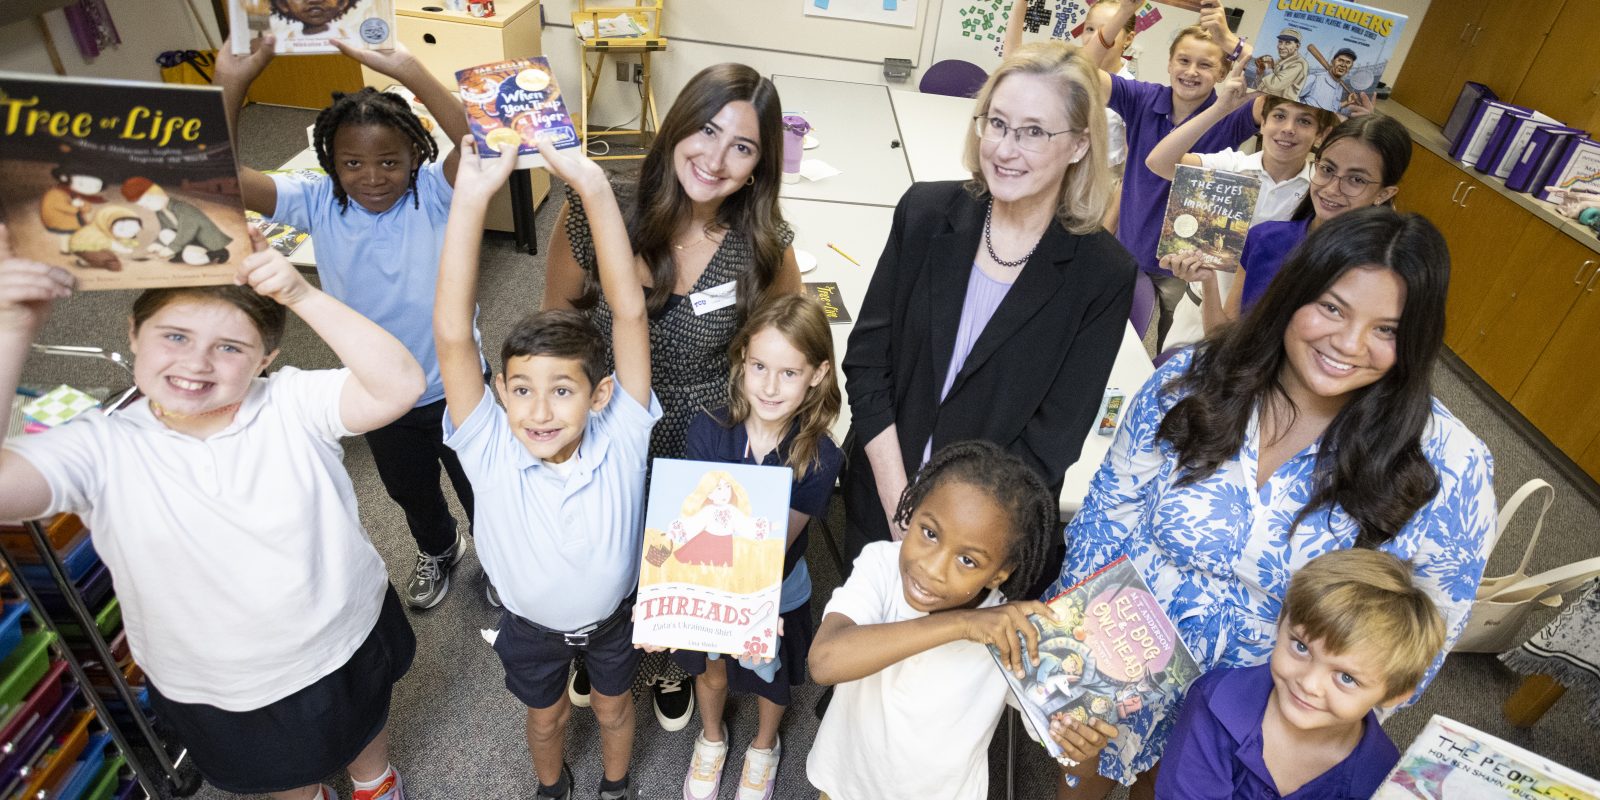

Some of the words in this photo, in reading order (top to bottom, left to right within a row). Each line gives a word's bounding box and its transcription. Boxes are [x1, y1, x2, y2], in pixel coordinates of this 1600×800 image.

[1277, 0, 1394, 37] CONTENDERS
[501, 89, 544, 103] When
[0, 88, 92, 137] Tree
[119, 105, 202, 147] Life
[501, 101, 531, 118] You
[530, 99, 561, 114] Trap
[528, 111, 565, 128] Tiger
[1191, 179, 1213, 190] THE
[1216, 184, 1243, 195] EYES
[1184, 198, 1243, 220] IMPOSSIBLE
[1212, 194, 1232, 205] THE
[694, 299, 706, 307] TCU
[640, 595, 751, 626] THREADS
[653, 621, 676, 632] Zlata's
[678, 621, 713, 634] Ukrainian
[715, 627, 733, 637] Shirt
[1116, 595, 1141, 622] ELF
[1130, 625, 1161, 660] DOG
[1141, 609, 1171, 651] ANDERSON
[1093, 602, 1117, 638] OWL
[1113, 631, 1143, 679] HEAD
[1439, 735, 1480, 763] THE
[1428, 749, 1450, 761] HOW
[1451, 759, 1471, 772] BEN
